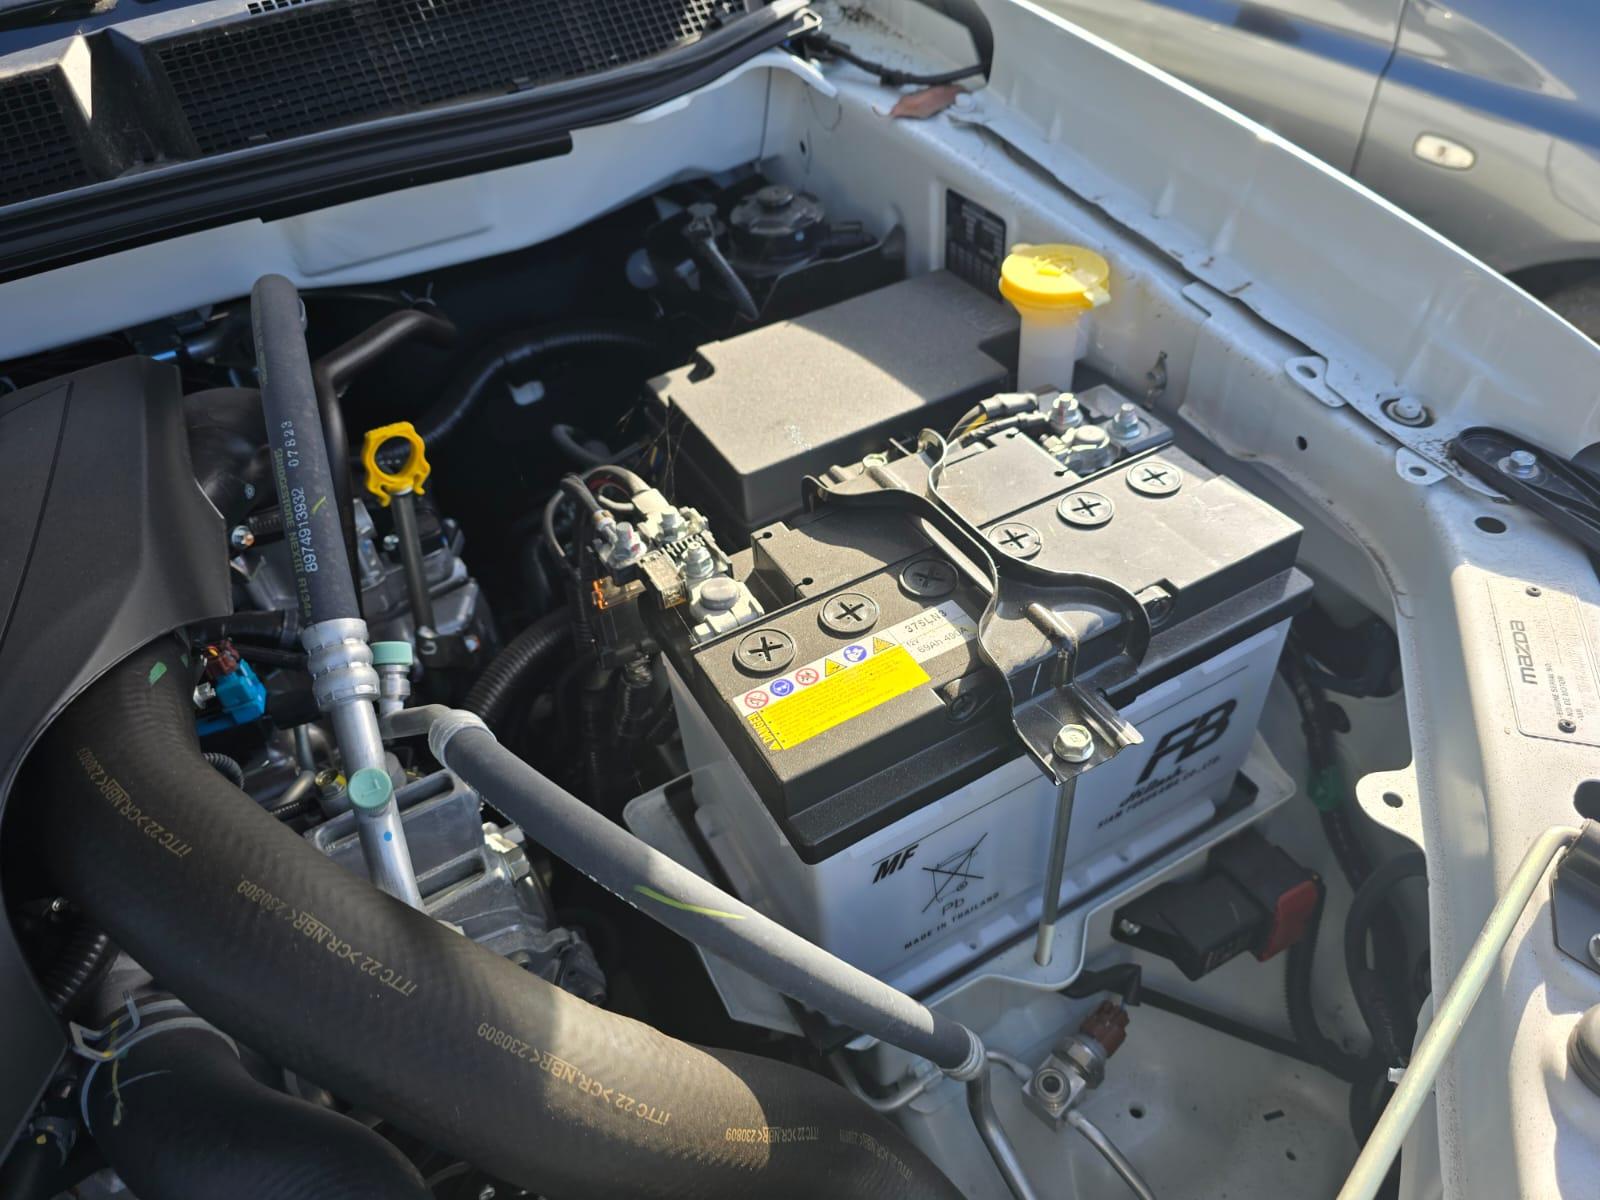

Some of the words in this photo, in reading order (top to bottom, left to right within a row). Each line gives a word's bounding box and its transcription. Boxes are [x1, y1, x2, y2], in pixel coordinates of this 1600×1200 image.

[281, 419, 299, 468] 07823
[291, 487, 319, 574] 8974913932
[904, 609, 948, 633] 375LN3
[1136, 699, 1238, 786] FB
[872, 843, 919, 885] MF
[903, 929, 933, 950] MADE
[936, 922, 947, 932] IN
[359, 956, 382, 976] 22
[615, 1092, 636, 1112] 22
[725, 1127, 756, 1143] 230809
